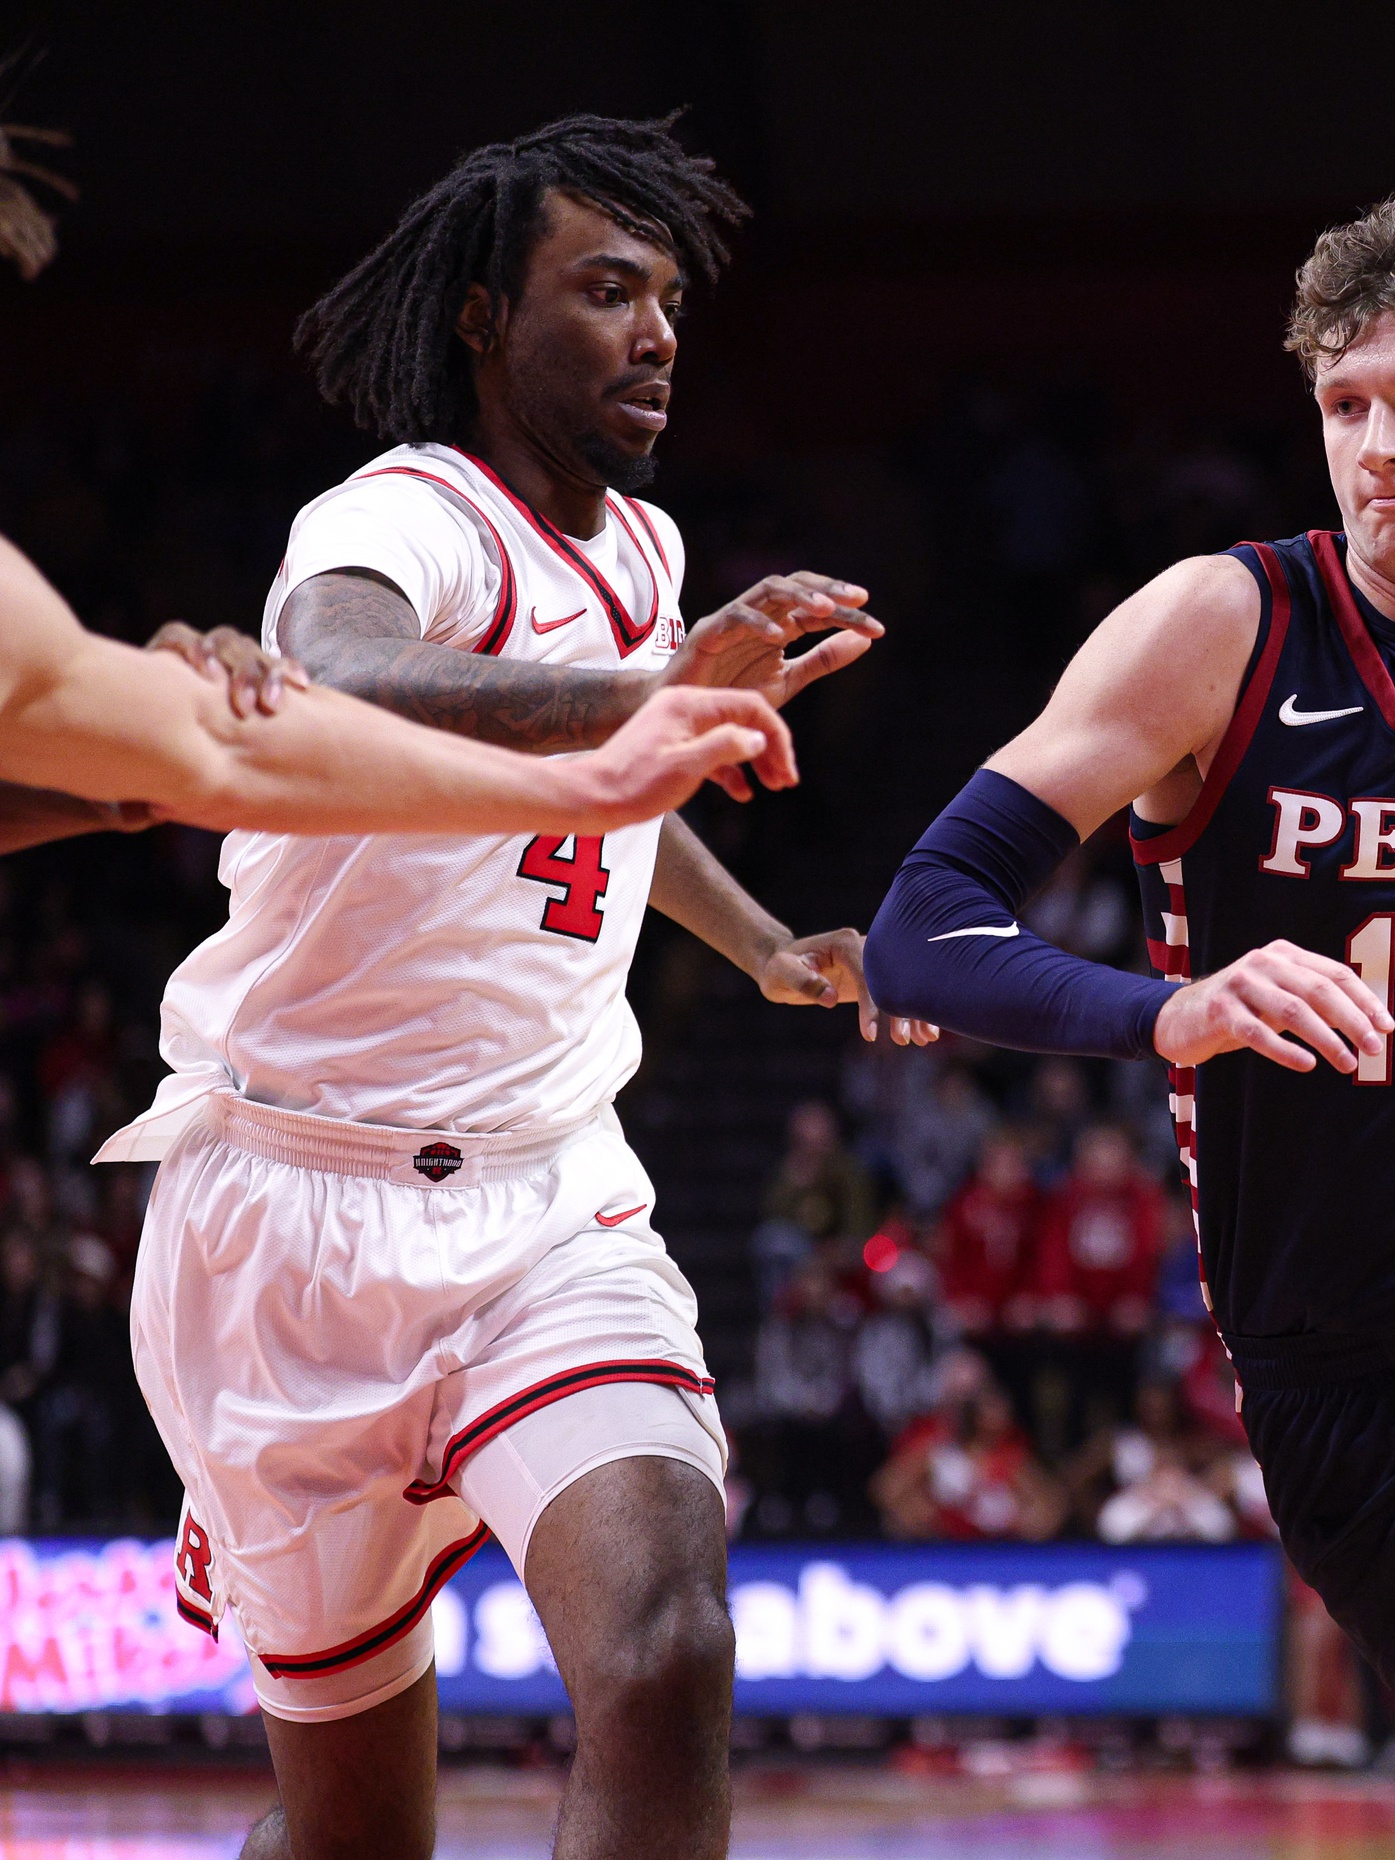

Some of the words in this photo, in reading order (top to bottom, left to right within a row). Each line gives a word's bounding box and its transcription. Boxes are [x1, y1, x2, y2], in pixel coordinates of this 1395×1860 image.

[516, 833, 610, 943] 4
[177, 1507, 213, 1604] R
[728, 1562, 1130, 1682] above
